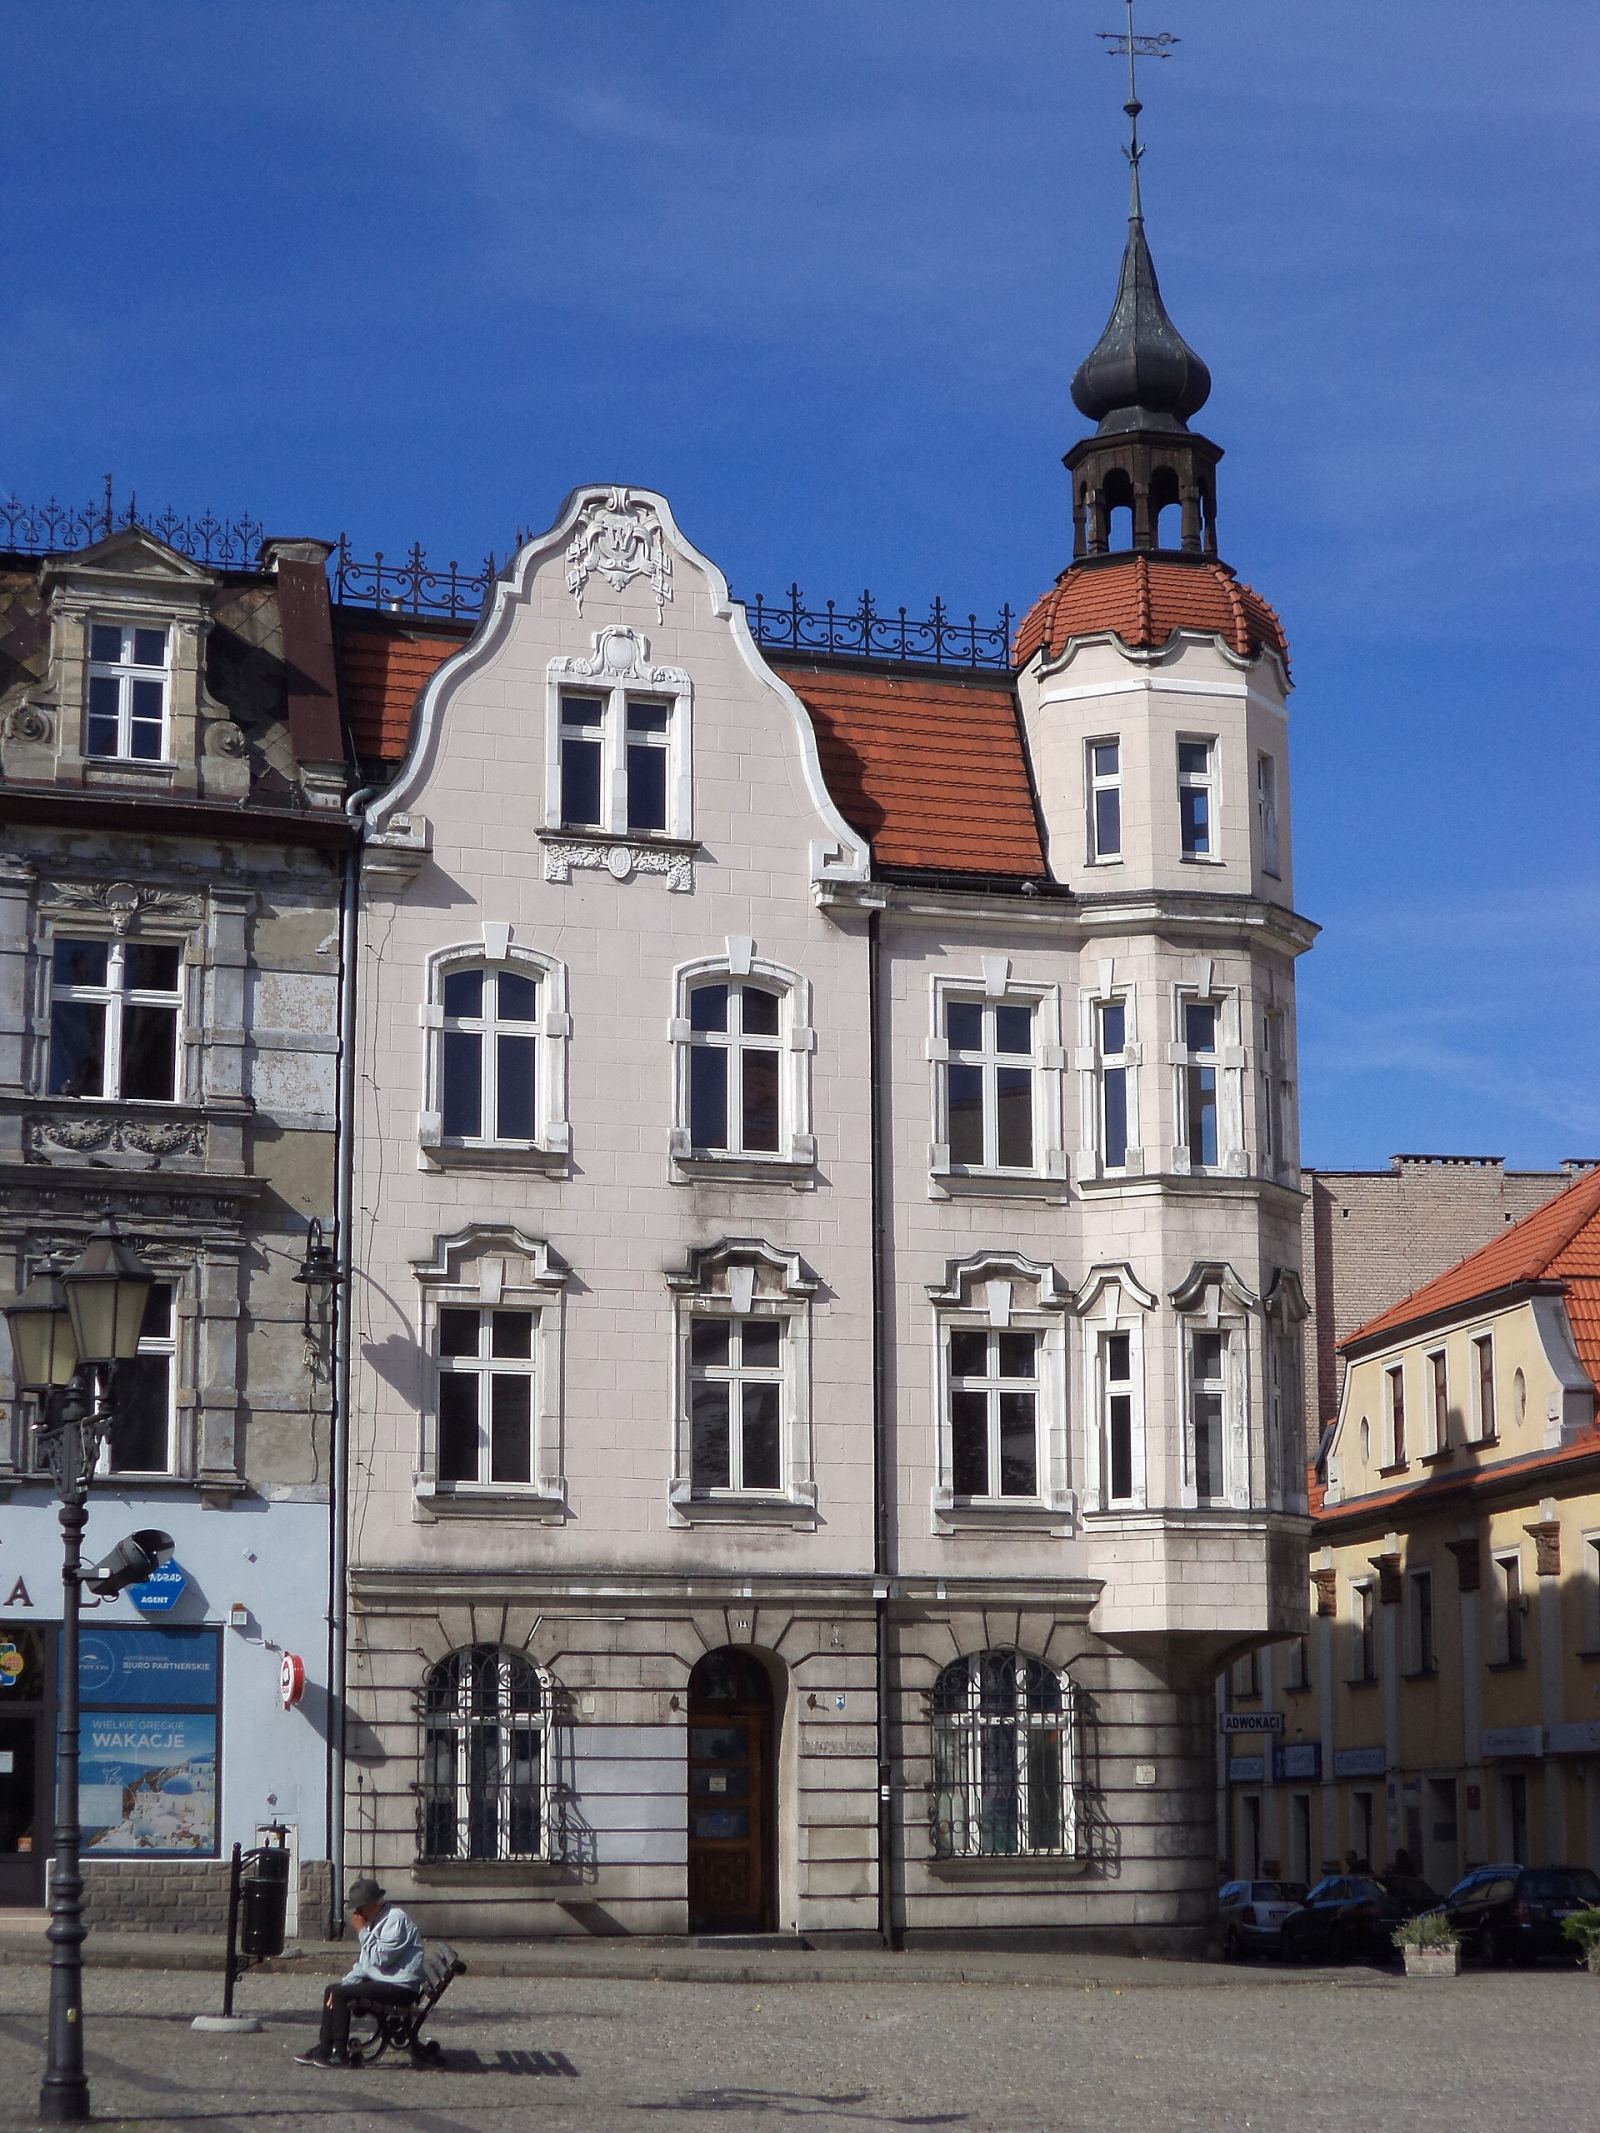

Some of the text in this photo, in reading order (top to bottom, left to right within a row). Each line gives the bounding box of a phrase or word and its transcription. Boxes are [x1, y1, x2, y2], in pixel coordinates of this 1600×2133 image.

[141, 1596, 168, 1604] AGENT
[123, 1662, 211, 1671] BIURO PARTNERSKIE
[92, 1720, 185, 1730] WIELKIE GRECKIE
[1226, 1717, 1280, 1729] ADWOKACI
[92, 1733, 185, 1748] WAKACJE
